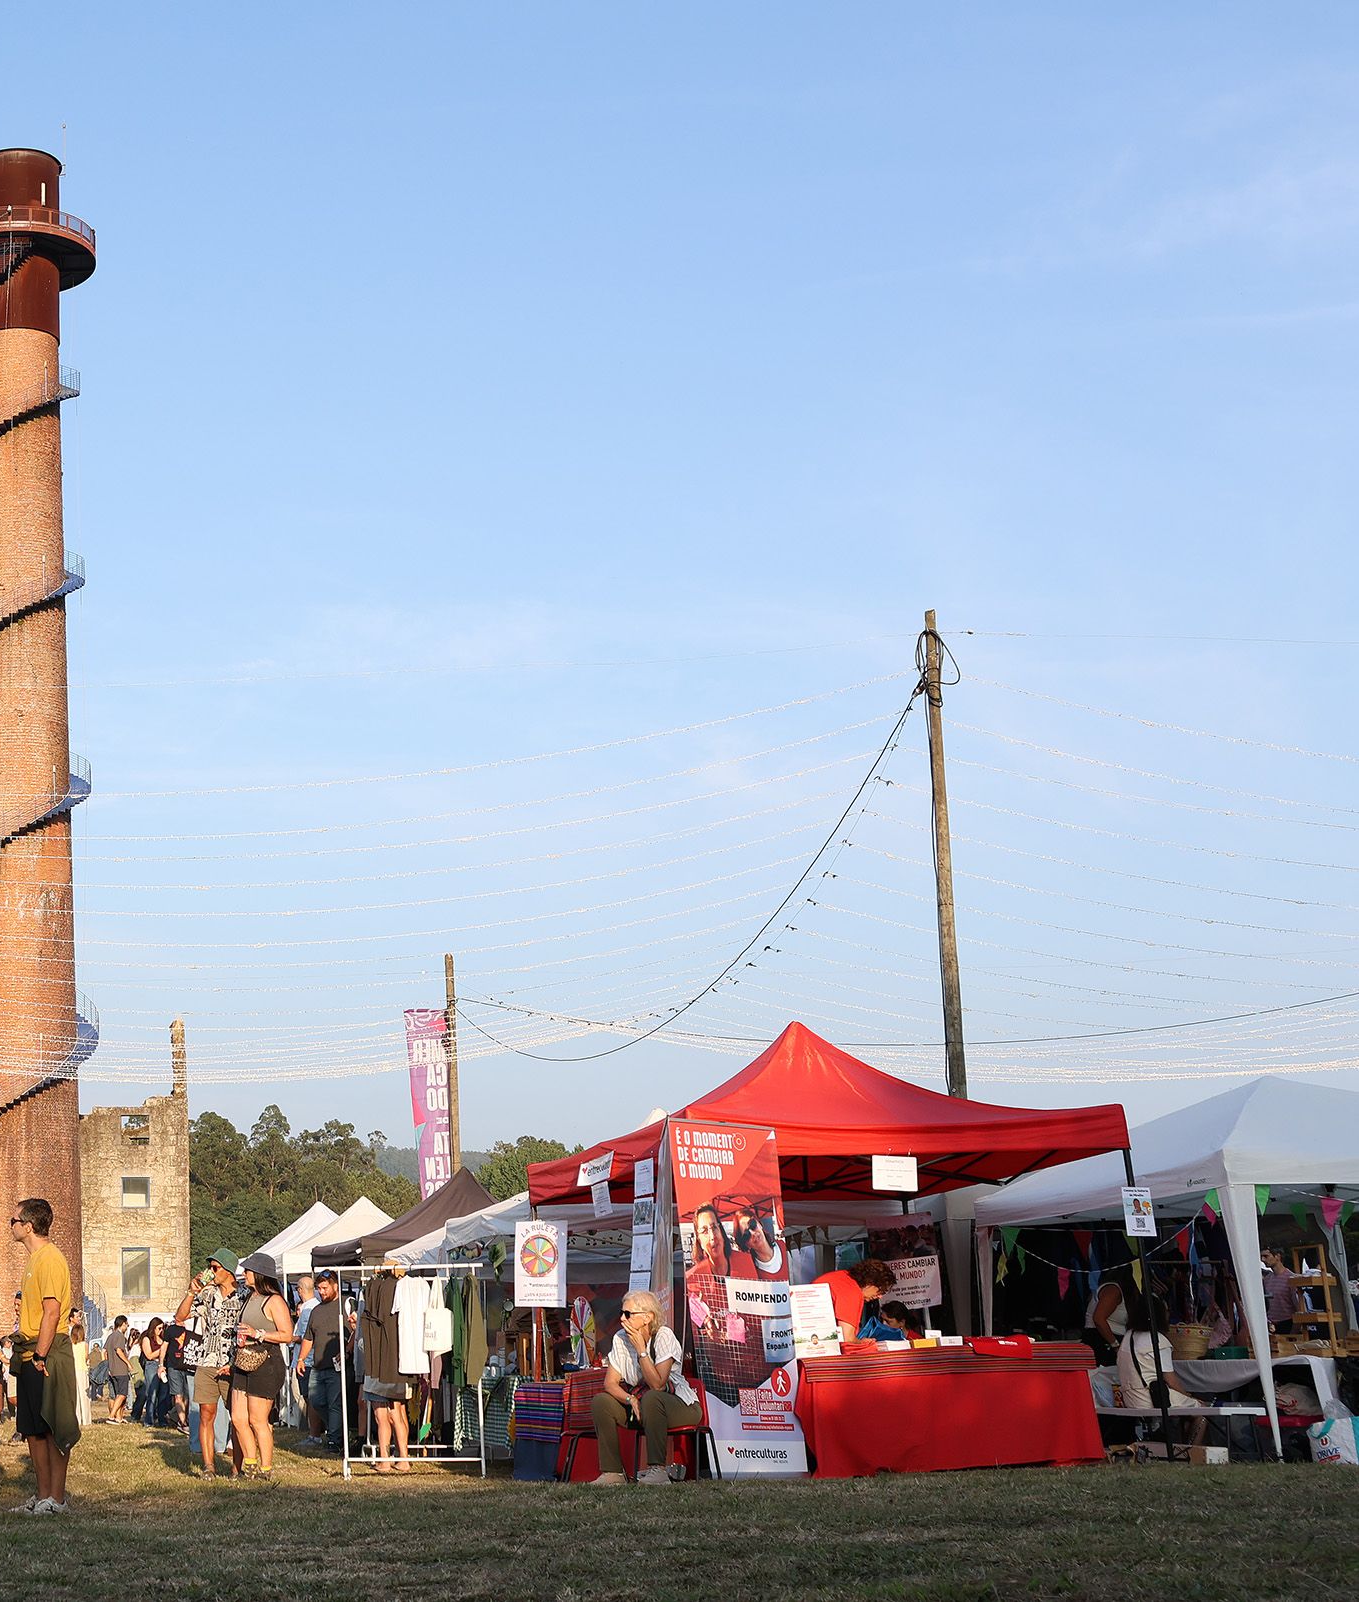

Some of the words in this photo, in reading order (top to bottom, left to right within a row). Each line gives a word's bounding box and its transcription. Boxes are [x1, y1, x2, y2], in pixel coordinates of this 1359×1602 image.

[675, 1127, 682, 1145] É
[683, 1130, 691, 1146] O
[677, 1146, 690, 1162] DE
[691, 1147, 735, 1165] CAMBIAR
[679, 1162, 687, 1178] O
[688, 1163, 723, 1181] MUNDO
[520, 1229, 530, 1238] LA
[531, 1224, 559, 1238] RULETA
[907, 1258, 936, 1269] CAMBIAR
[899, 1270, 926, 1280] MUNDO?
[735, 1291, 788, 1303] ROMPIENDO
[766, 1342, 788, 1351] España
[734, 1448, 788, 1459] entreculturas
[1316, 1447, 1340, 1459] DRIVE
